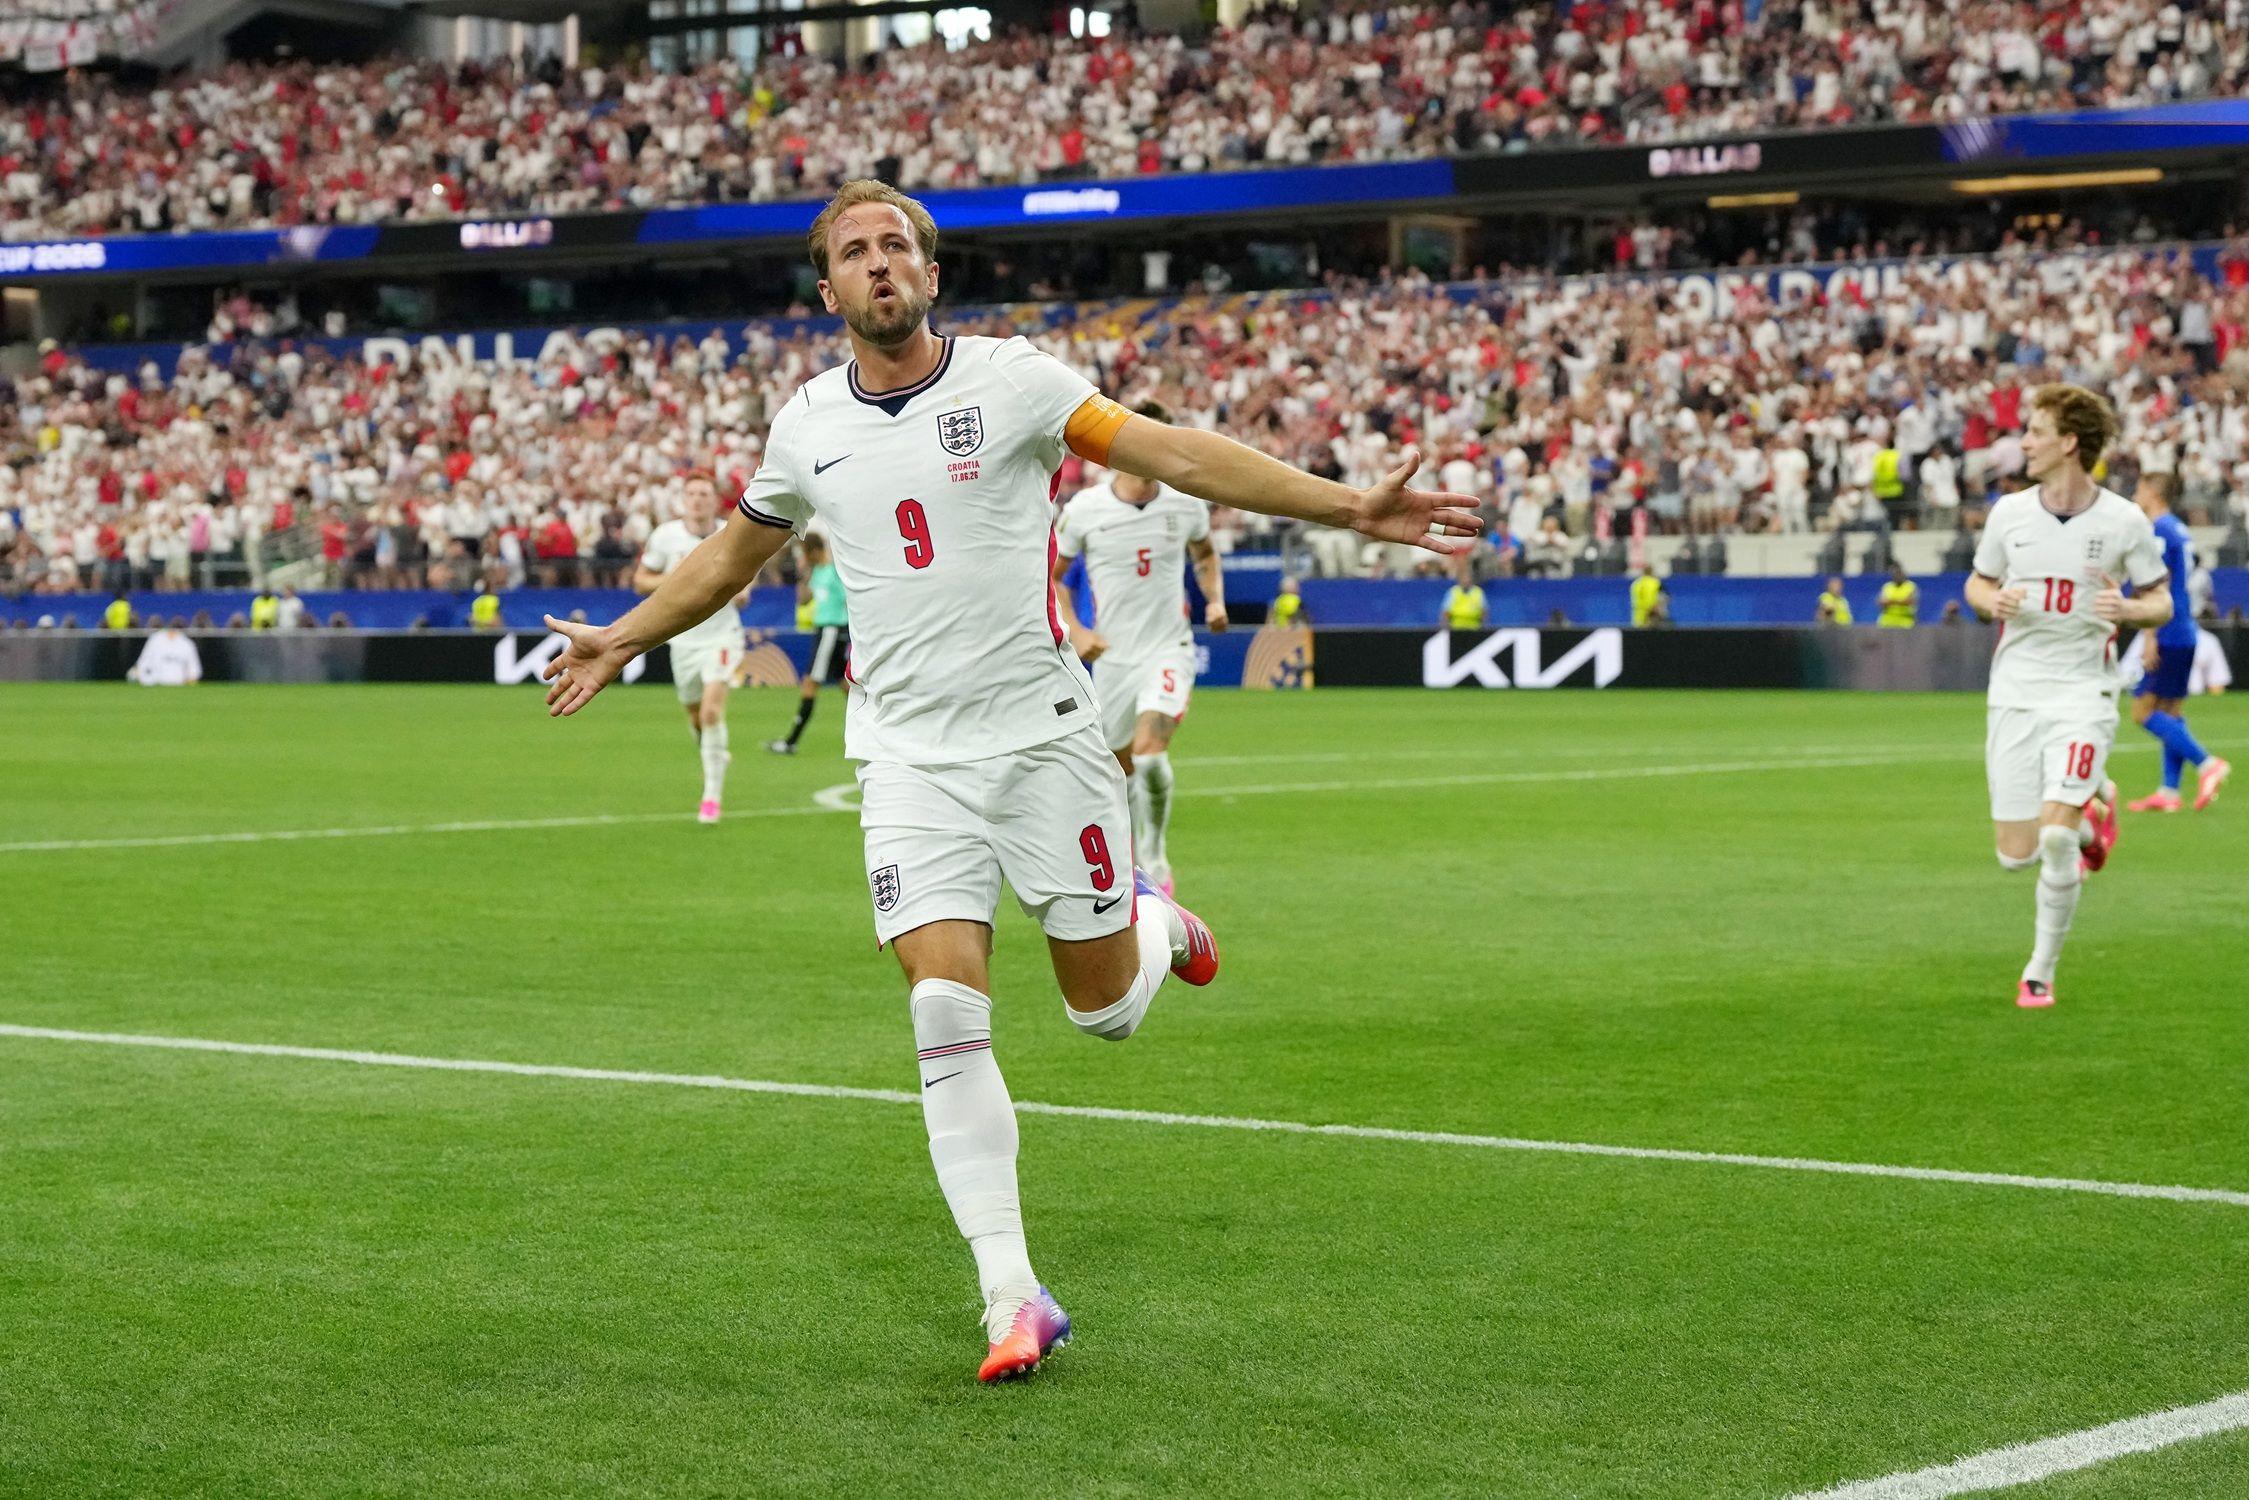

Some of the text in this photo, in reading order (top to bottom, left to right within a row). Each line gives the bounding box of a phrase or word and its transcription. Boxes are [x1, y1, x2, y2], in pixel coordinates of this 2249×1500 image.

[947, 460, 980, 472] CROATIA
[951, 471, 979, 482] 17.06.26
[895, 498, 935, 570] 9
[1137, 548, 1152, 577] 5
[2043, 577, 2075, 614] 18
[1162, 668, 1176, 693] 5
[2066, 741, 2095, 780] 18
[1079, 823, 1115, 892] 9
